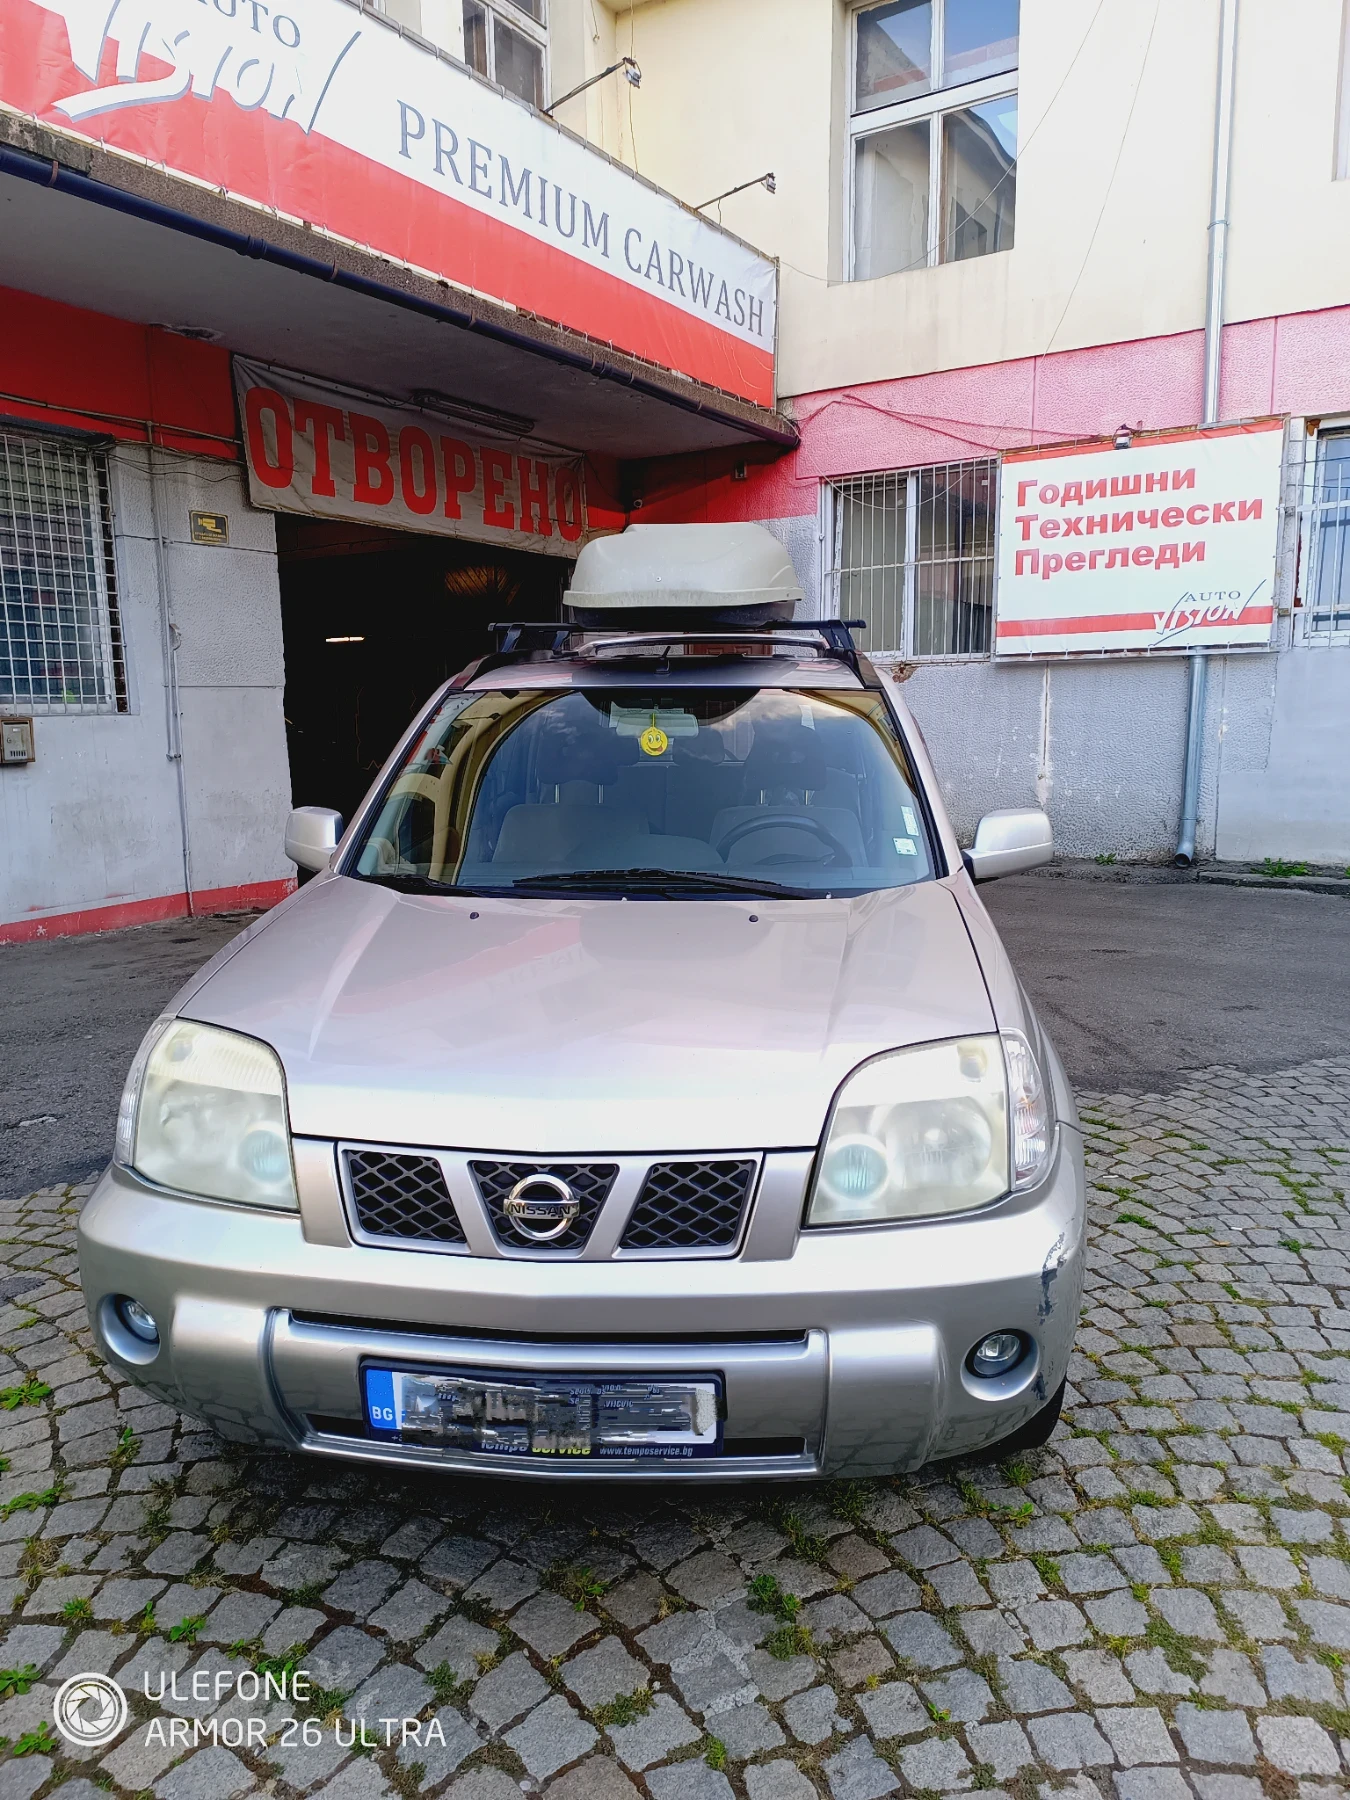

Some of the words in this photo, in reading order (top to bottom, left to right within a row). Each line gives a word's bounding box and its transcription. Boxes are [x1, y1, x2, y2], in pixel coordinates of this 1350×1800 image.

[195, 0, 301, 48] UTO
[396, 99, 609, 259] PREMIUM
[624, 227, 764, 336] CARWASH
[245, 386, 583, 542] ОТВОРЕНО
[1017, 468, 1196, 507] Годишни
[1014, 499, 1263, 541] Технически
[1014, 541, 1206, 580] Прегледи
[1148, 579, 1267, 646] VISION
[1184, 590, 1241, 602] AUTO
[510, 1203, 571, 1218] NISSAN
[371, 1405, 394, 1421] BG
[599, 1445, 694, 1457] www.temposervice.bg
